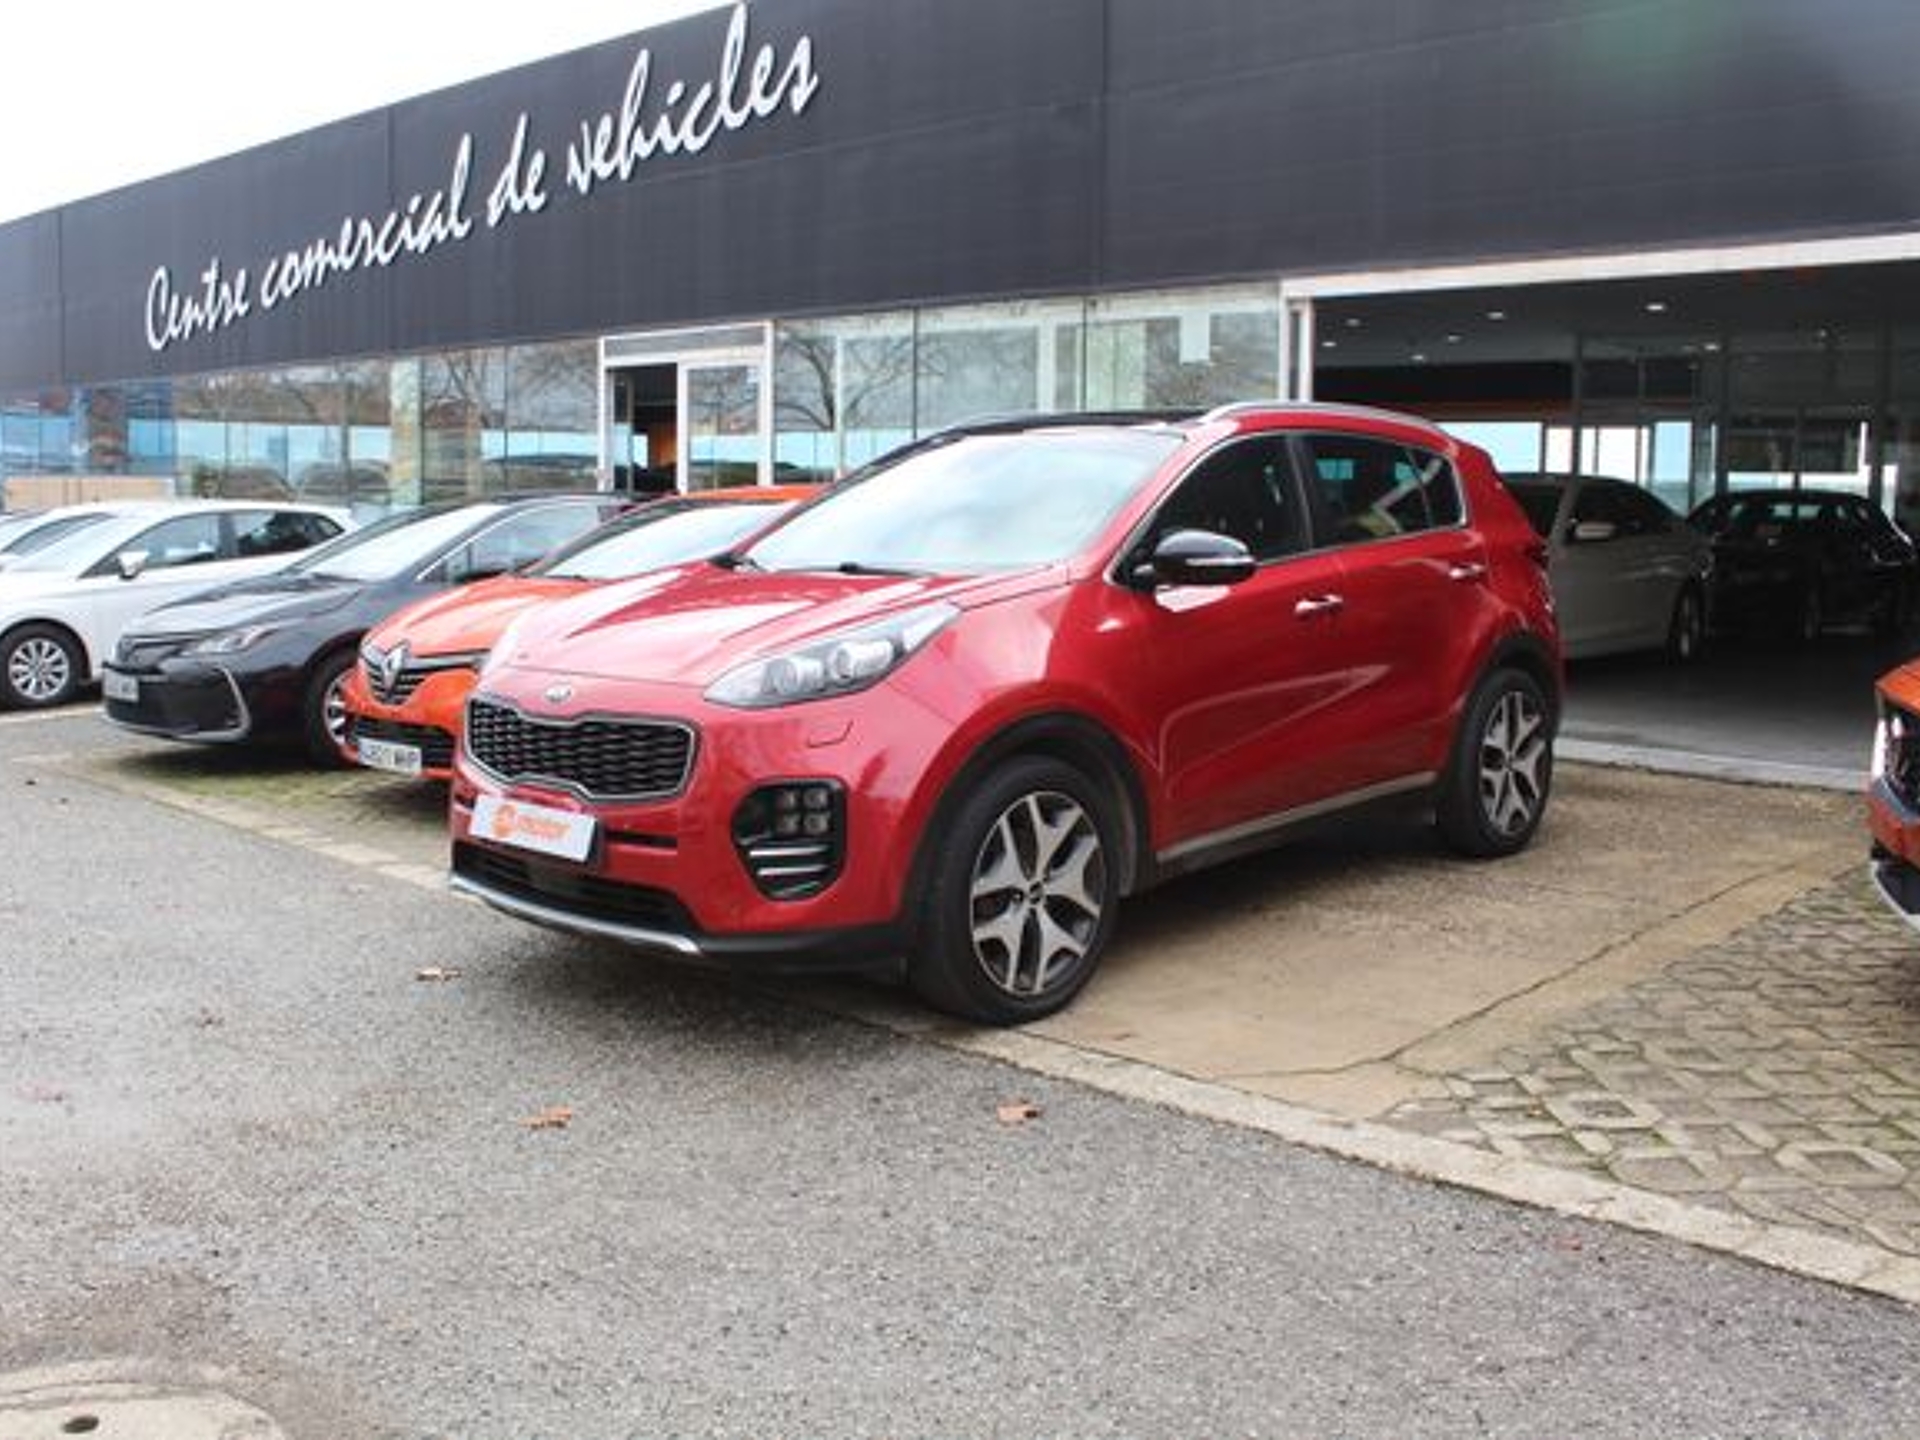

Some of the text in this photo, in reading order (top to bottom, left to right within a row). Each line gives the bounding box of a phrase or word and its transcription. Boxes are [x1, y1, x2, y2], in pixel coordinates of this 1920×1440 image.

[145, 1, 819, 351] Centre comercial de vehicles
